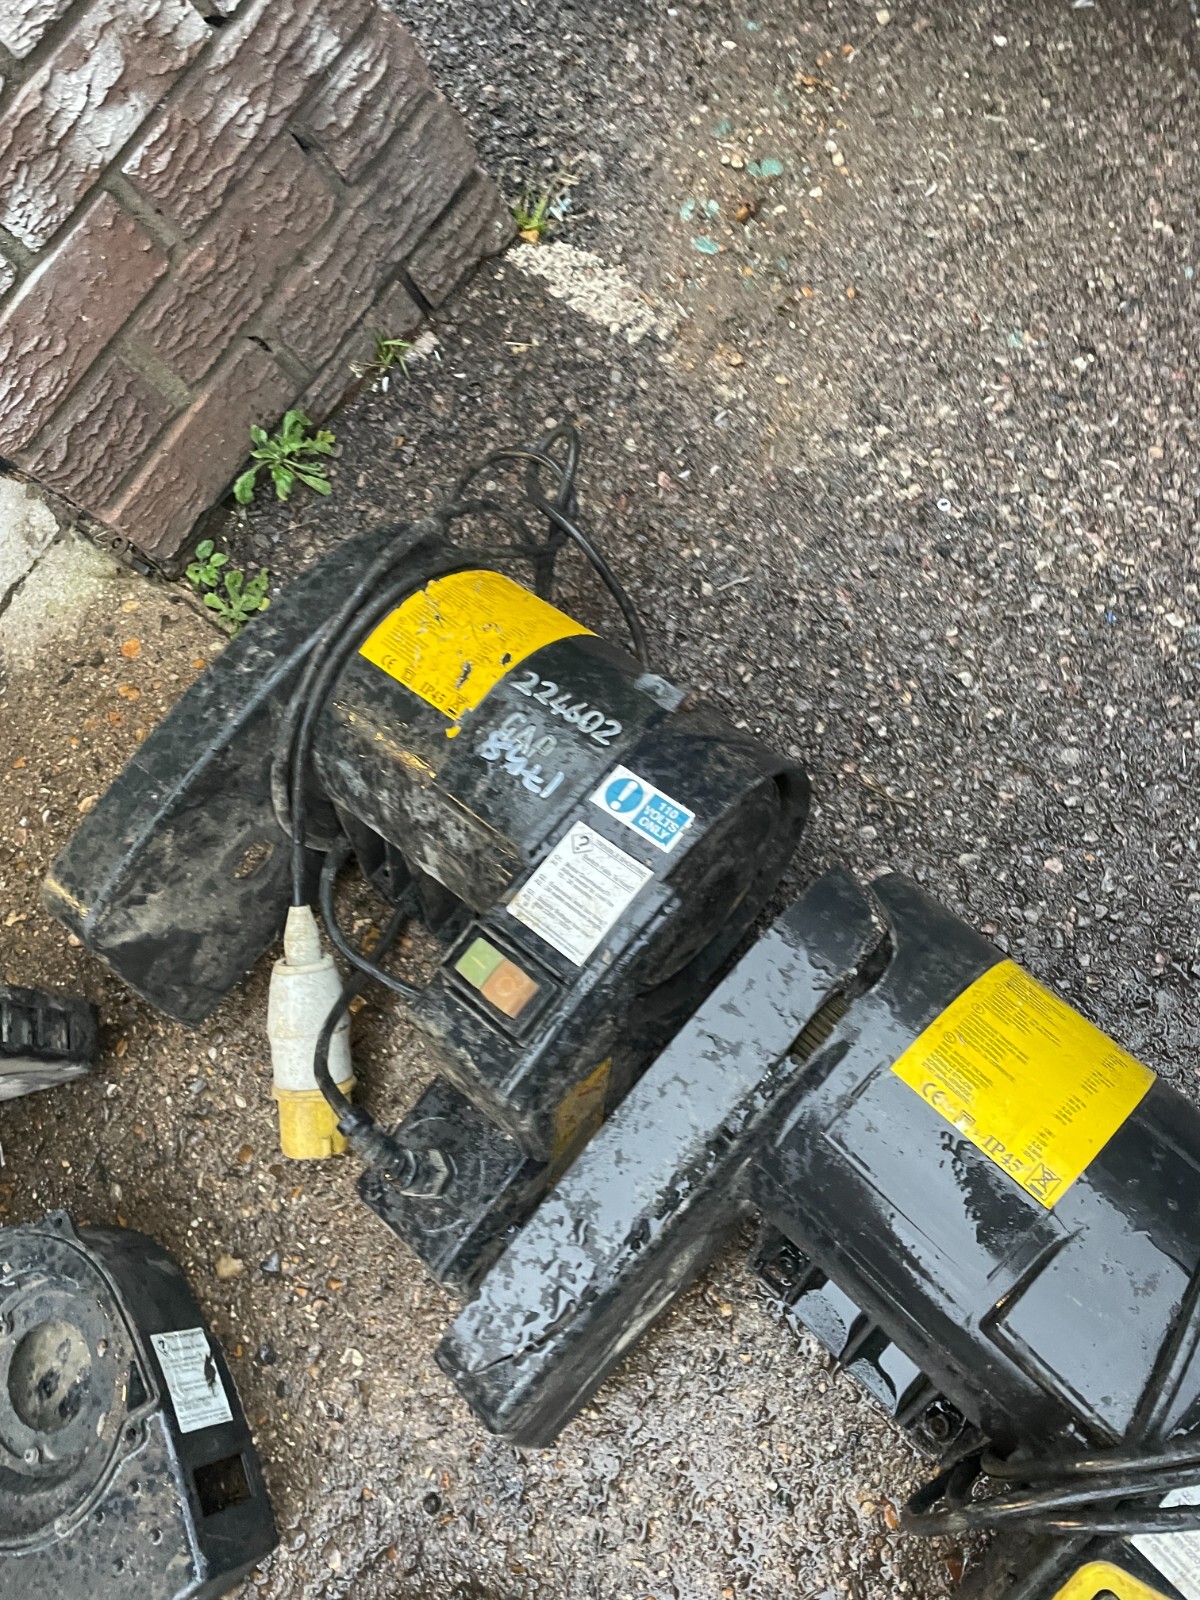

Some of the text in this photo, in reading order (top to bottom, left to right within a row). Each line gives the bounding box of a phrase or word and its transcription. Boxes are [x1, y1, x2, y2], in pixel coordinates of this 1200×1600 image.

[419, 680, 446, 705] IP45
[508, 671, 623, 746] 224602
[643, 805, 680, 833] VOLTS
[658, 801, 680, 820] 110
[638, 819, 671, 841] ONLY
[982, 1134, 1025, 1173] IP45
